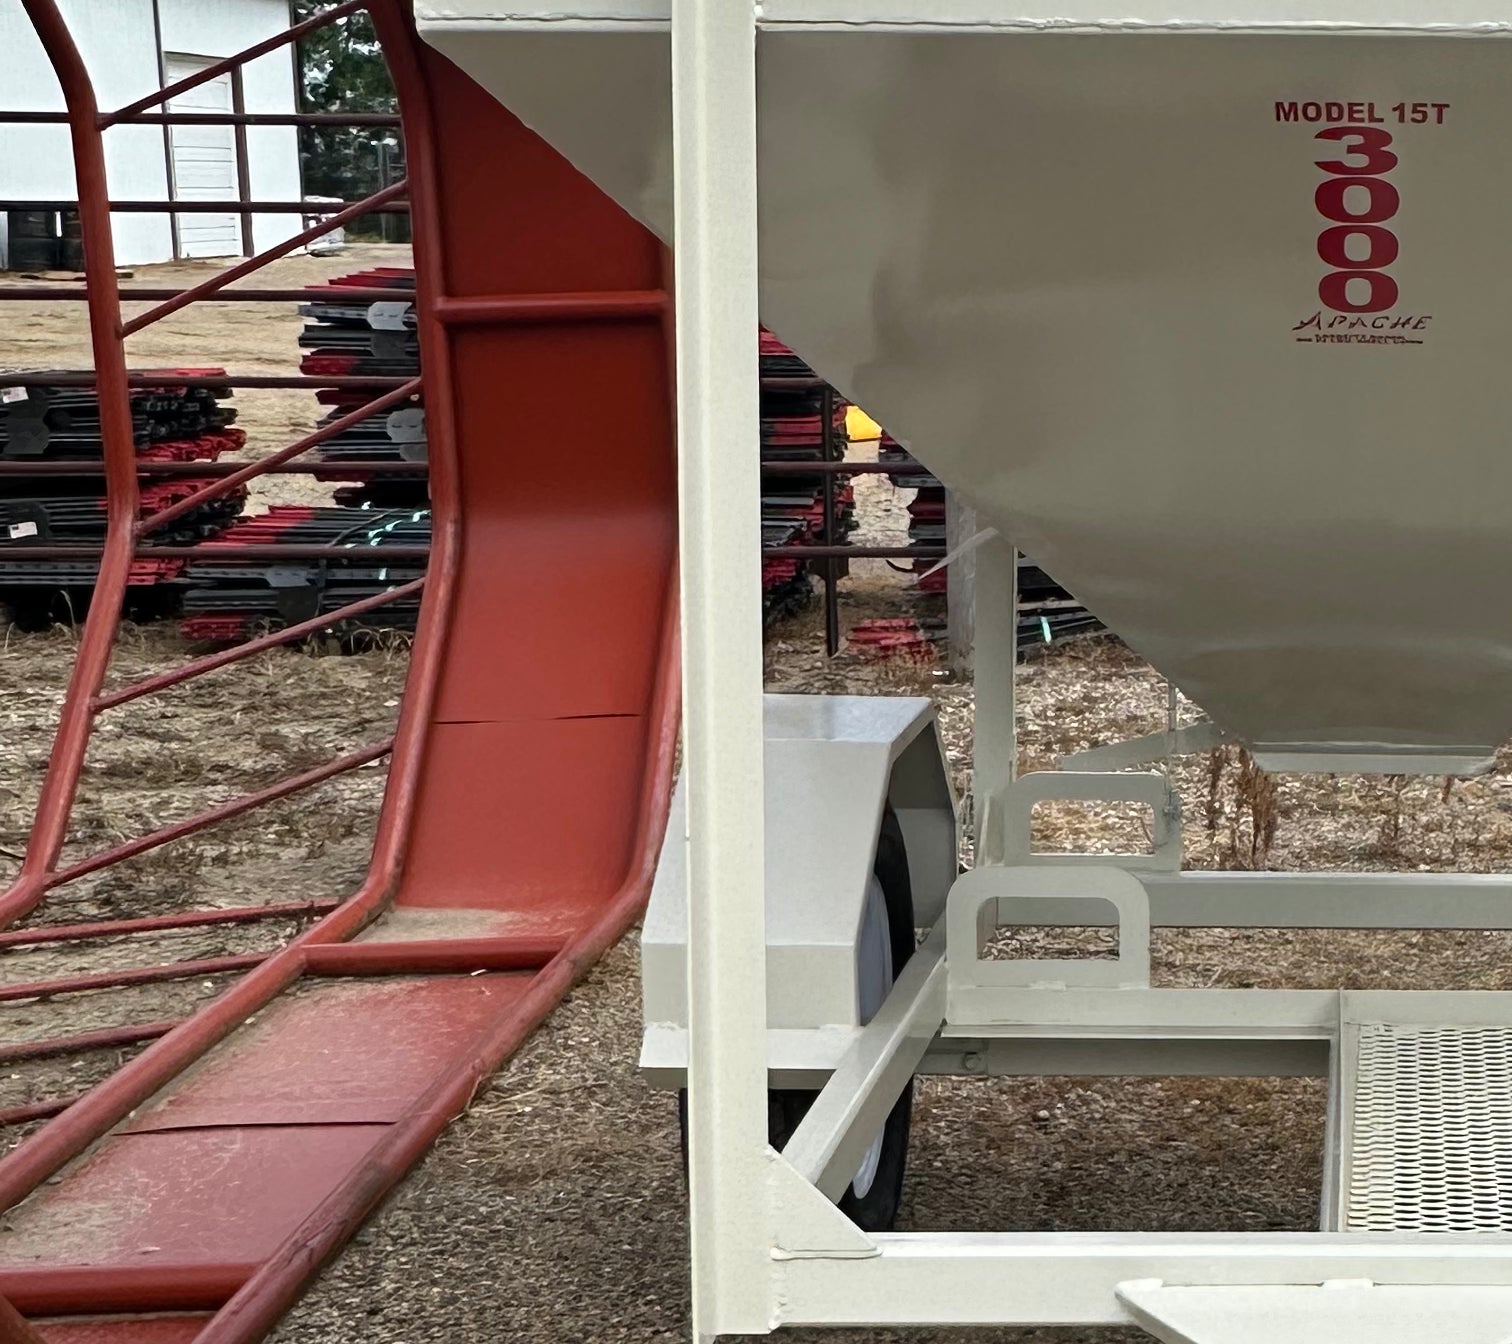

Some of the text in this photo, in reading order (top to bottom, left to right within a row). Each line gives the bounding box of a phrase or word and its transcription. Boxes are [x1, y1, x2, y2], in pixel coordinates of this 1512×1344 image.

[1275, 102, 1451, 124] MODEL 15T
[1313, 126, 1400, 314] 3000
[1292, 311, 1433, 331] APACHE
